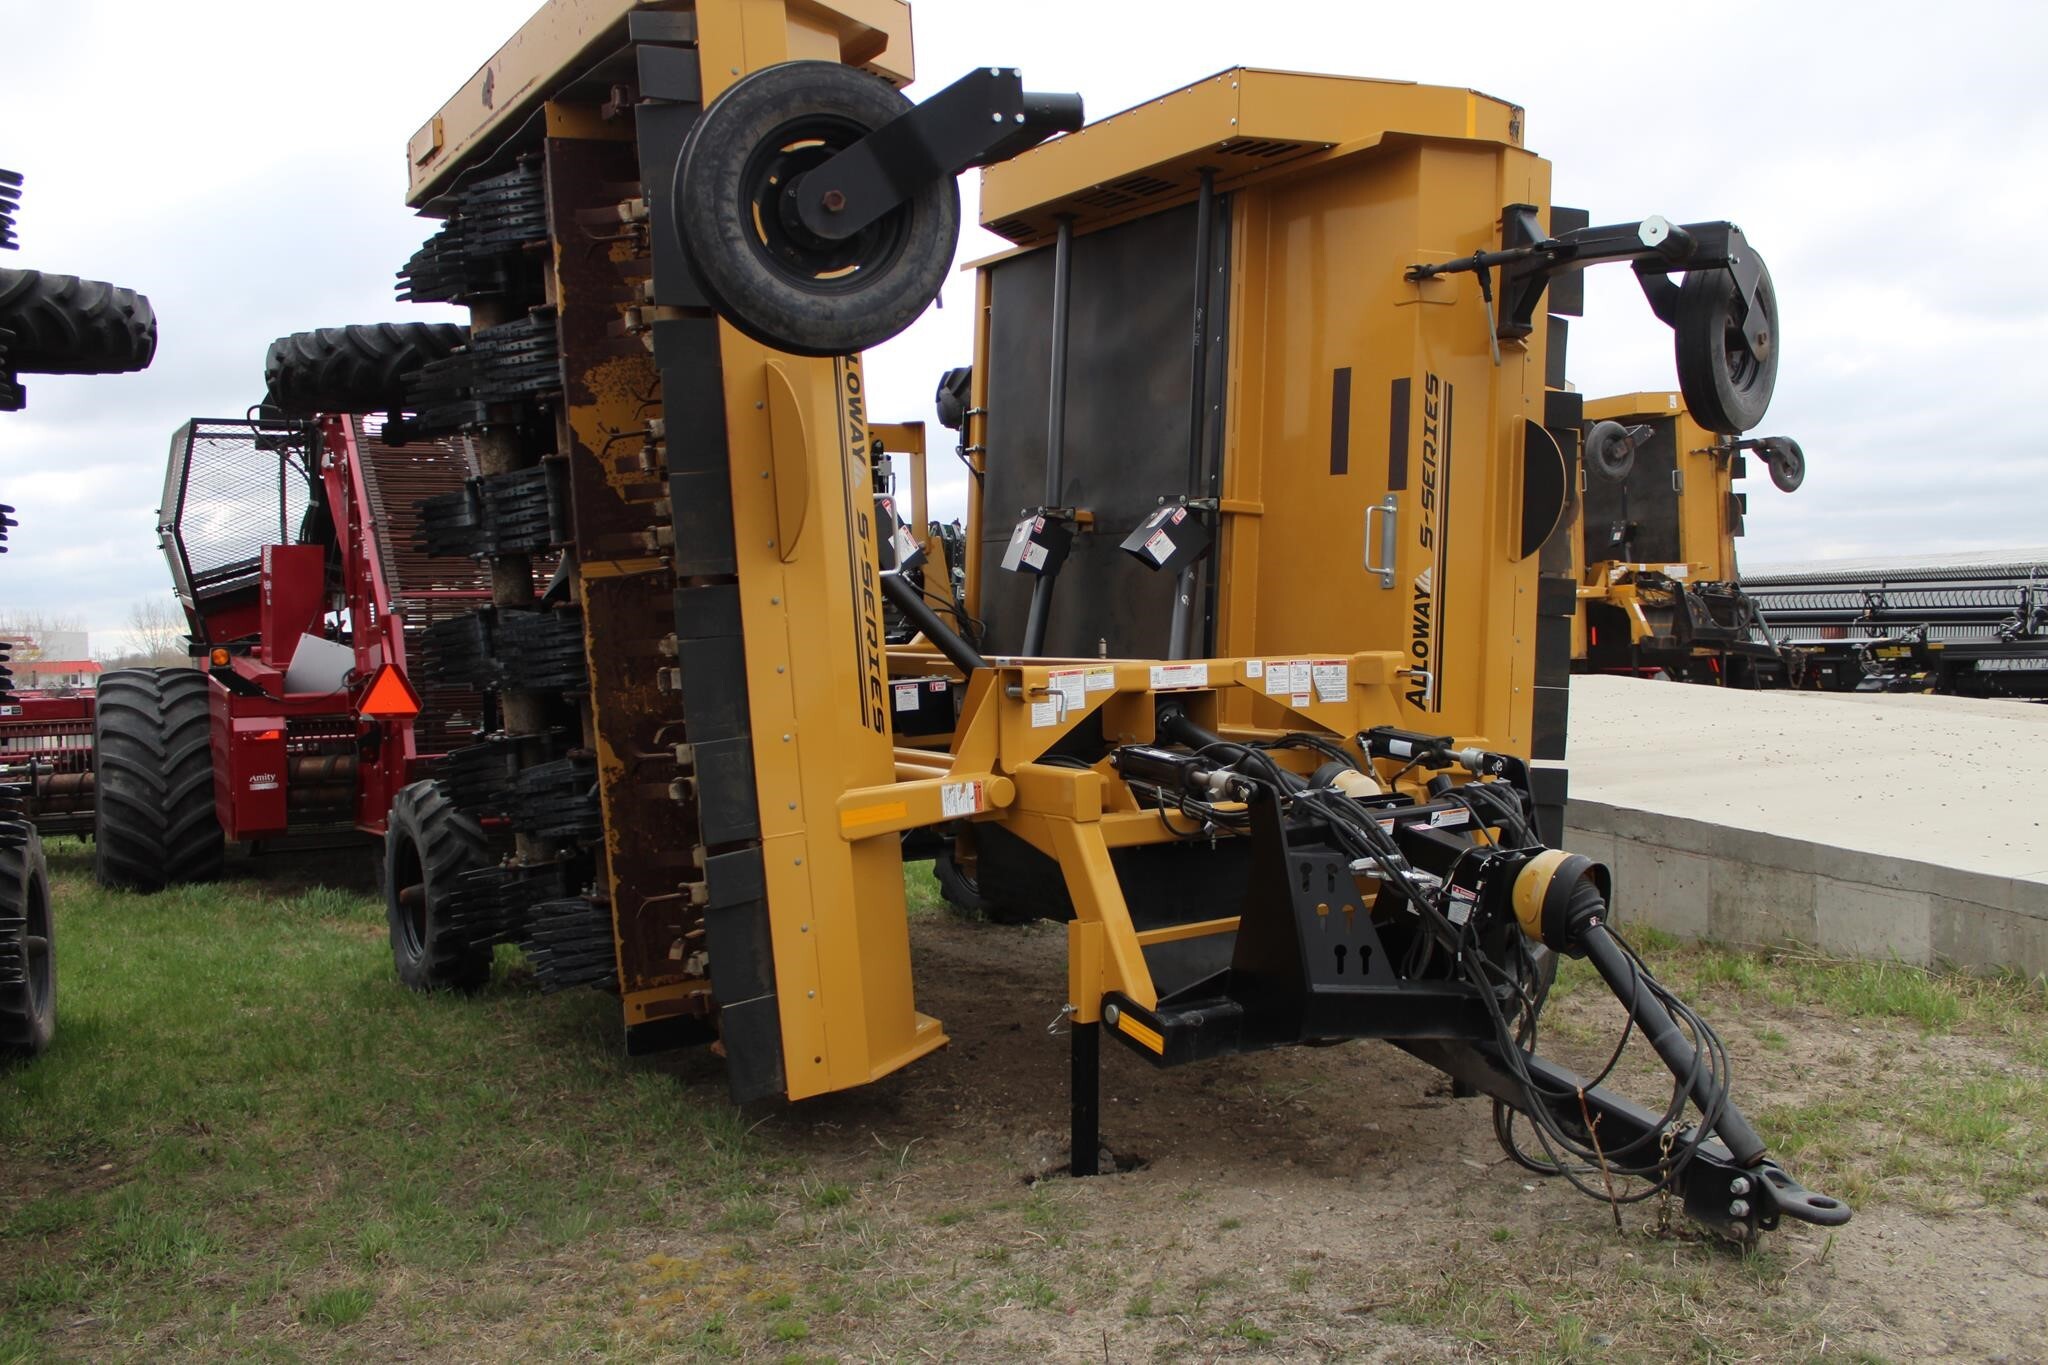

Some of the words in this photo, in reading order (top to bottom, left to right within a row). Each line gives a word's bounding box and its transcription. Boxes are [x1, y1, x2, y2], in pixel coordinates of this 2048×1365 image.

[845, 354, 867, 466] LOWAY
[857, 512, 886, 736] S-SERIES
[1405, 583, 1431, 712] ALLOWAY
[1419, 370, 1439, 551] S-SERIES
[249, 773, 276, 782] Amity
